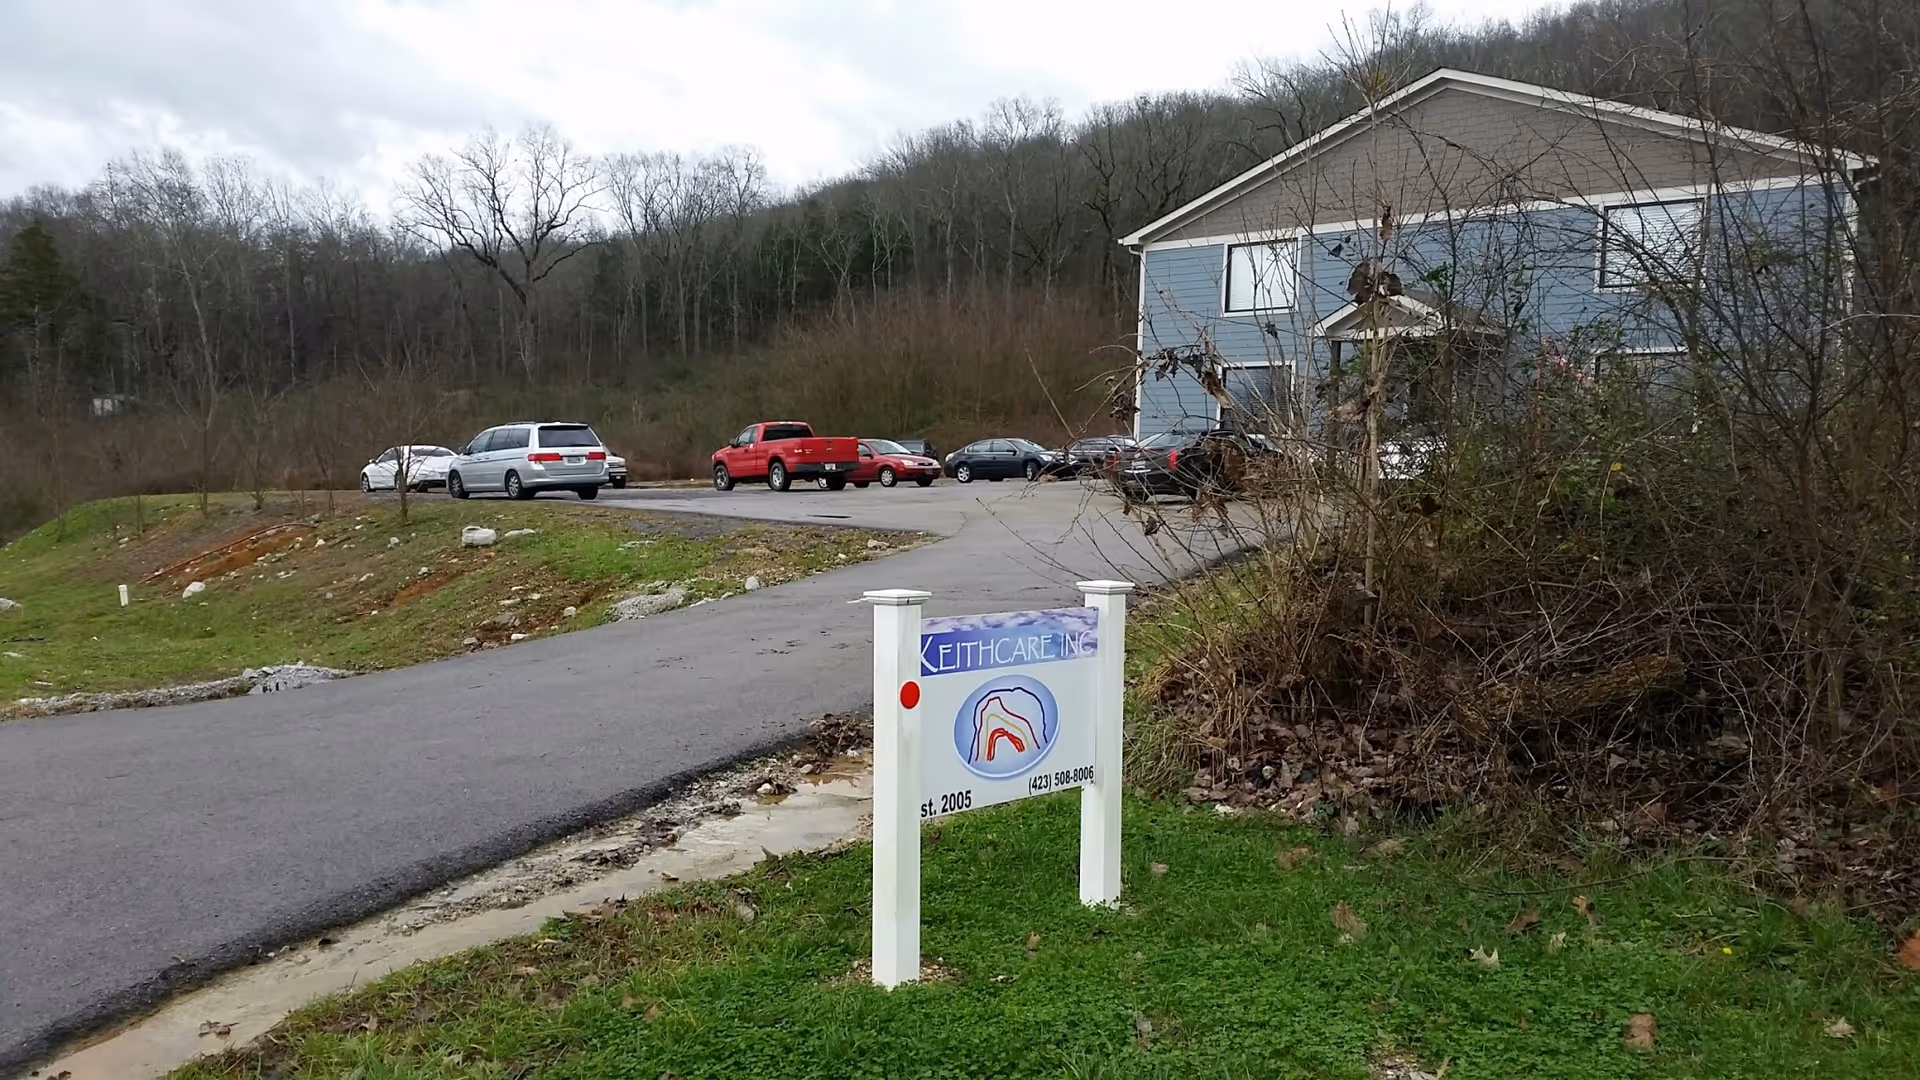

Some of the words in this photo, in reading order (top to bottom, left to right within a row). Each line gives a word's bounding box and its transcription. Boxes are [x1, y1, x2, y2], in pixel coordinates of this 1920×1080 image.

[921, 634, 1055, 673] KEITHCARE
[1060, 629, 1093, 657] INC
[1028, 773, 1051, 796] (423)
[1054, 765, 1094, 787] 508-8006
[920, 797, 937, 818] st.
[940, 789, 972, 814] 2005
